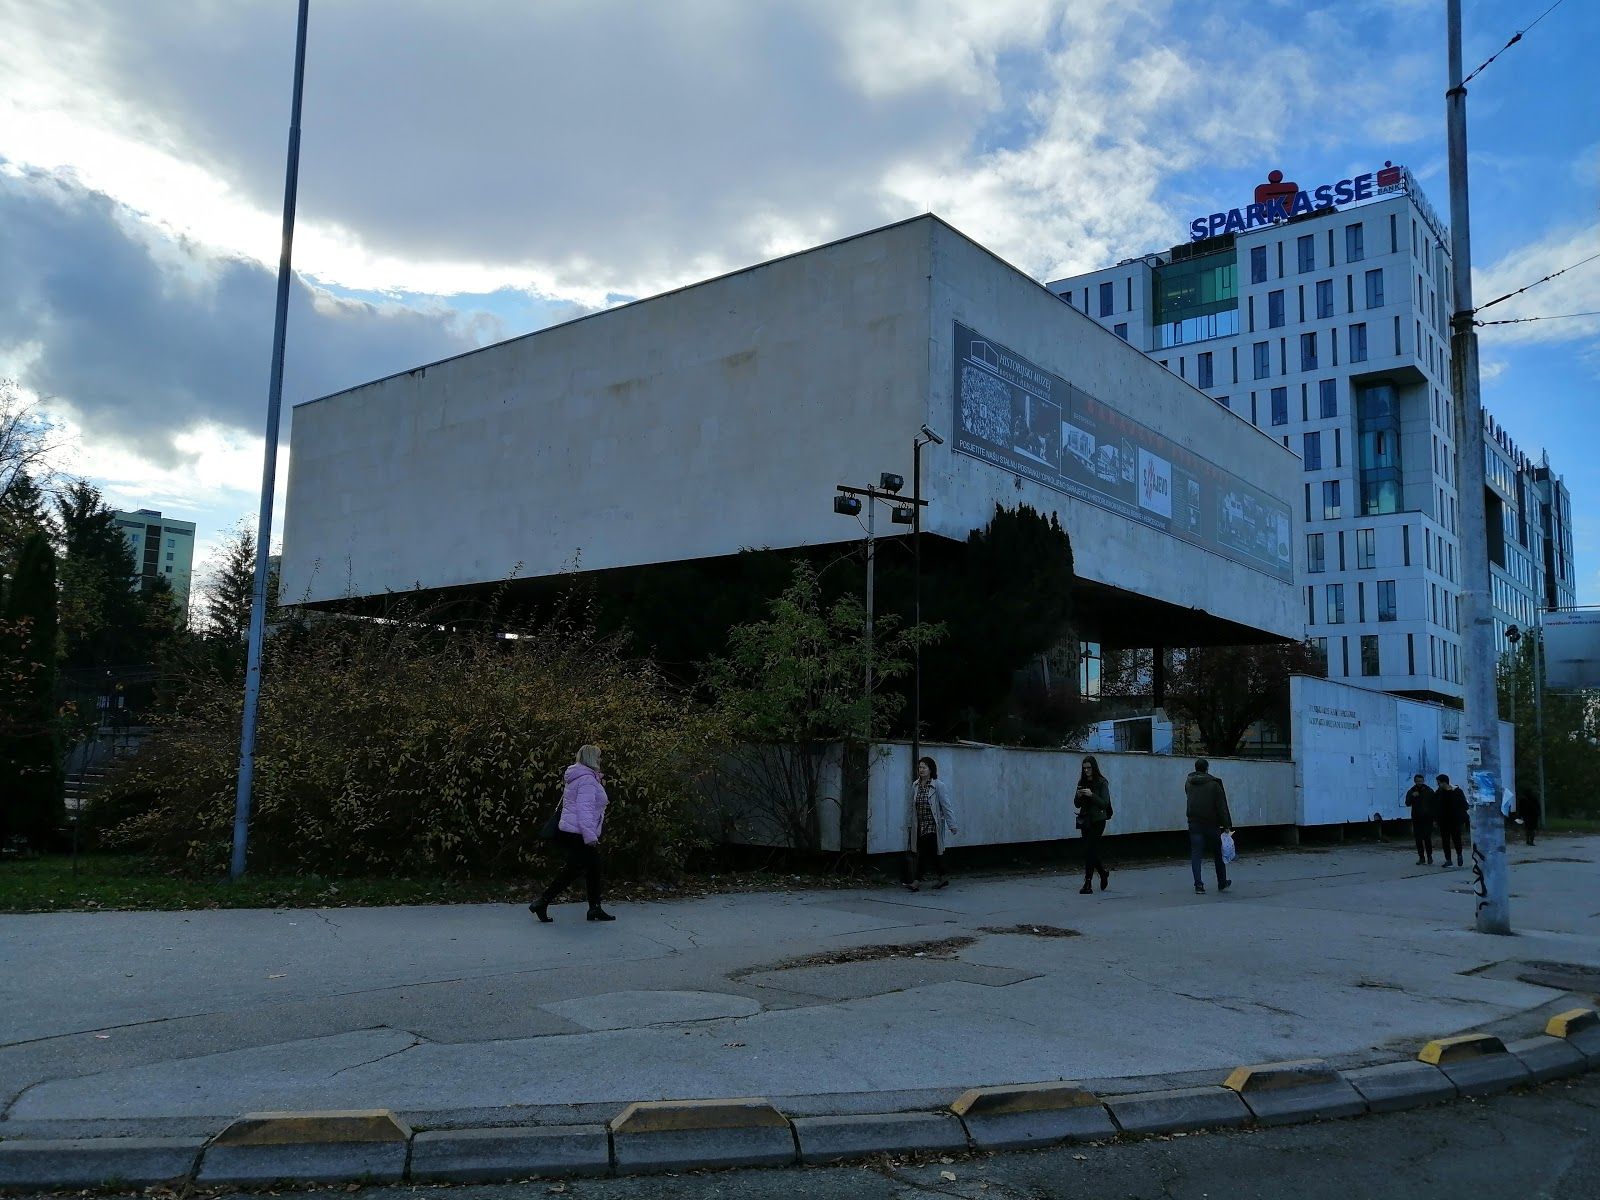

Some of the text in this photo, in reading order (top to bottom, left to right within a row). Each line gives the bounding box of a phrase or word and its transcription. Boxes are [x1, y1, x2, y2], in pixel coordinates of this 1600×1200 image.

[1377, 183, 1402, 195] BANK
[1190, 172, 1373, 242] SPARKASSE
[999, 352, 1051, 391] HISTORIJSKI MUZEJ
[959, 439, 986, 456] POSJETITE
[986, 448, 999, 462] NAŠU
[1143, 464, 1168, 498] SAJEVO
